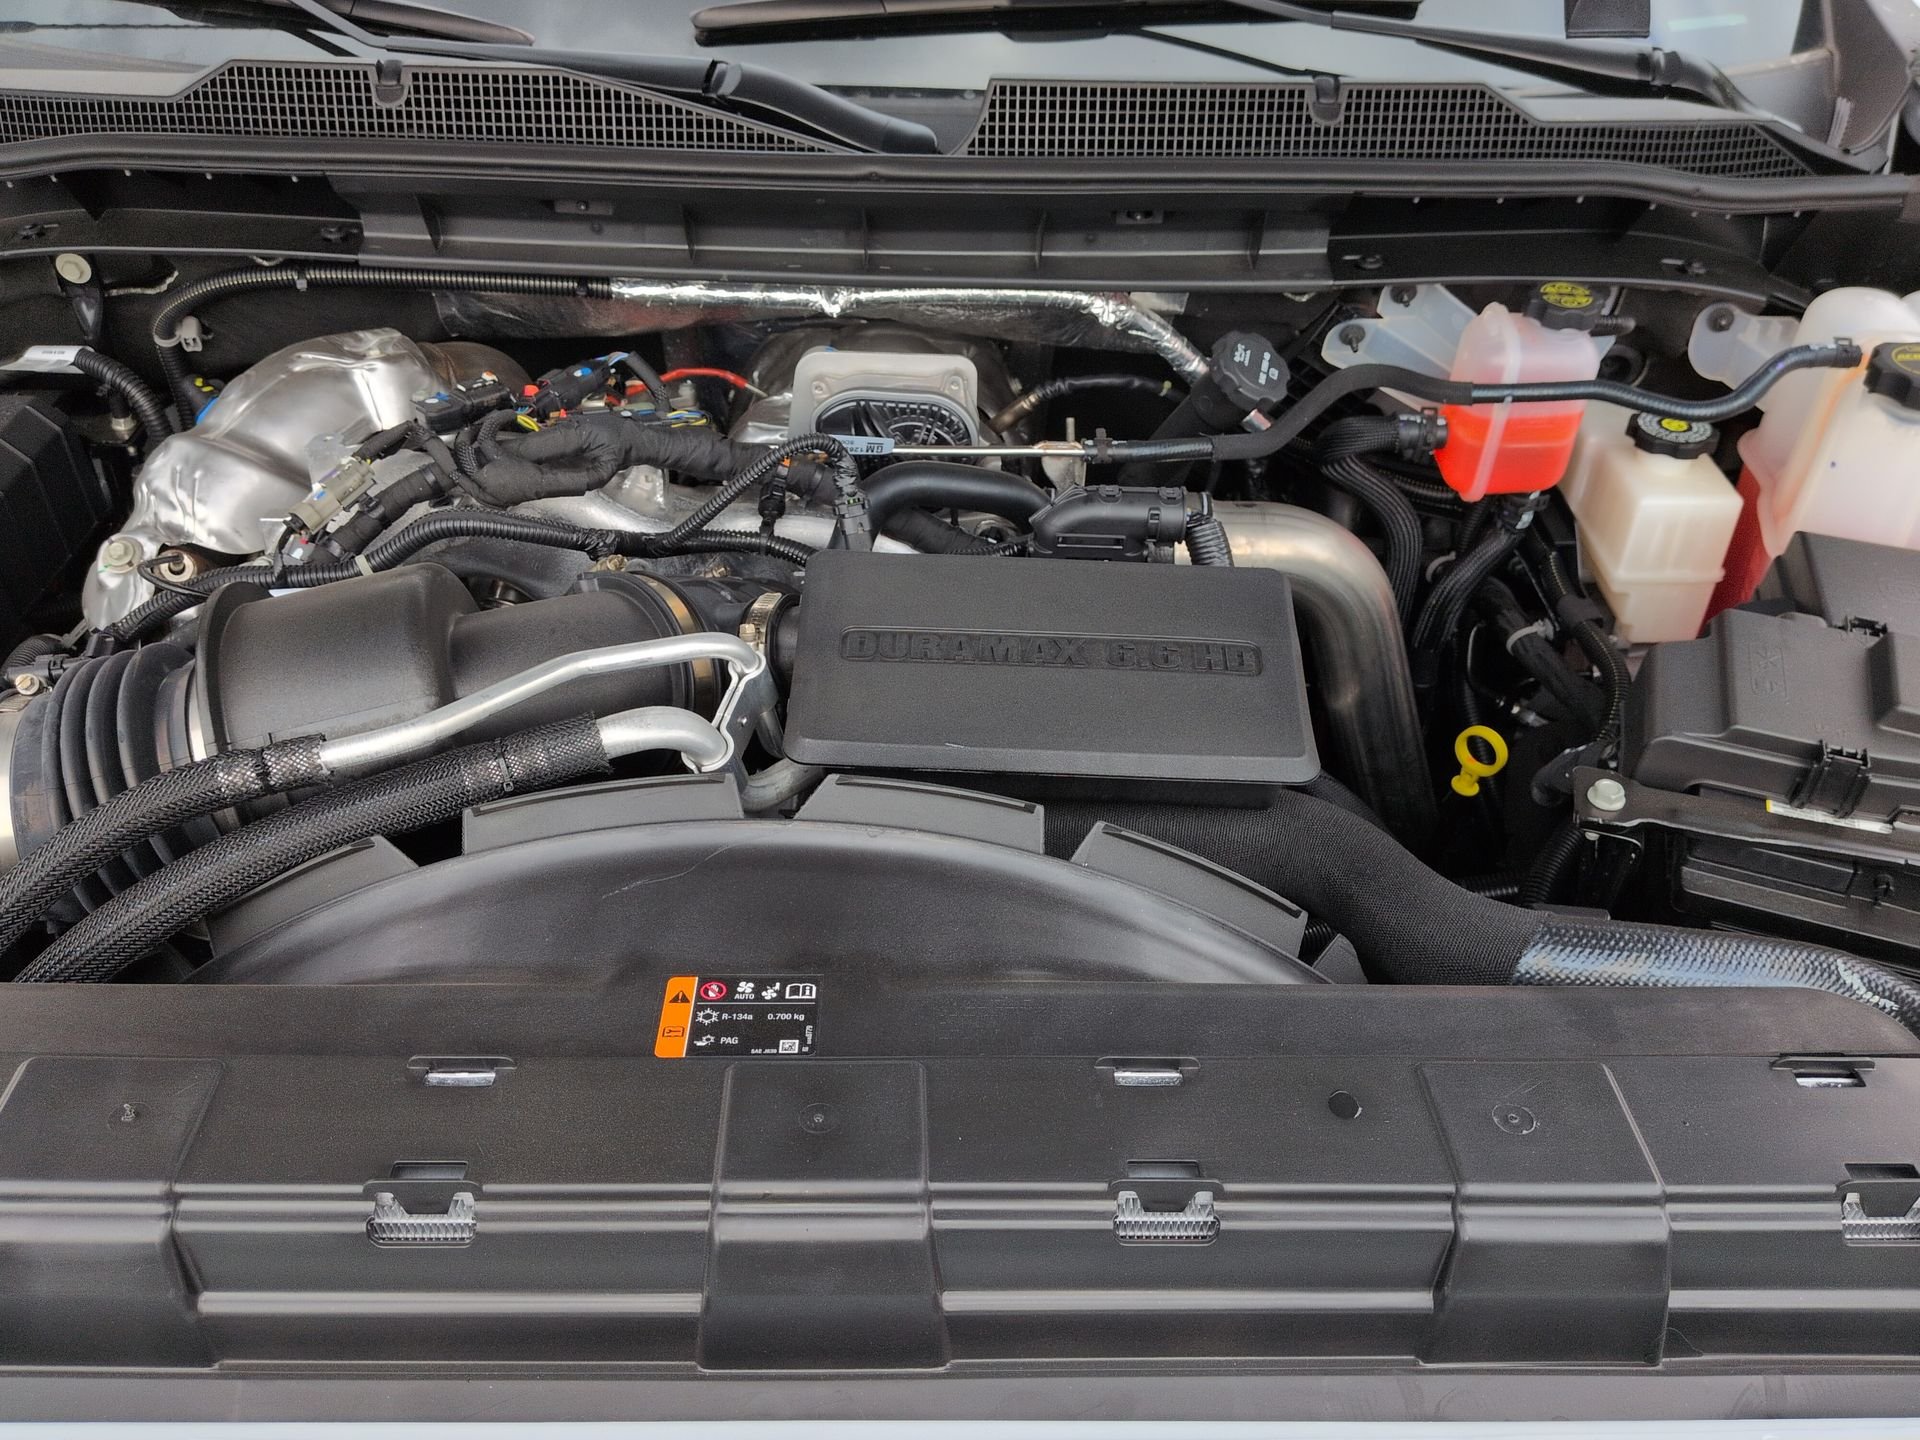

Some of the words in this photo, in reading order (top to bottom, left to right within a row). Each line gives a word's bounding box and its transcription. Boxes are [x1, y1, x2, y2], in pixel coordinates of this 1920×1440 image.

[865, 444, 884, 453] GM
[846, 631, 1090, 665] DURAMAX
[1107, 642, 1181, 669] 6.6
[1193, 645, 1261, 674] HD
[722, 1012, 753, 1021] R-134a
[767, 1012, 792, 1021] 0.700
[793, 1012, 805, 1021] kg
[720, 1036, 739, 1045] PAG
